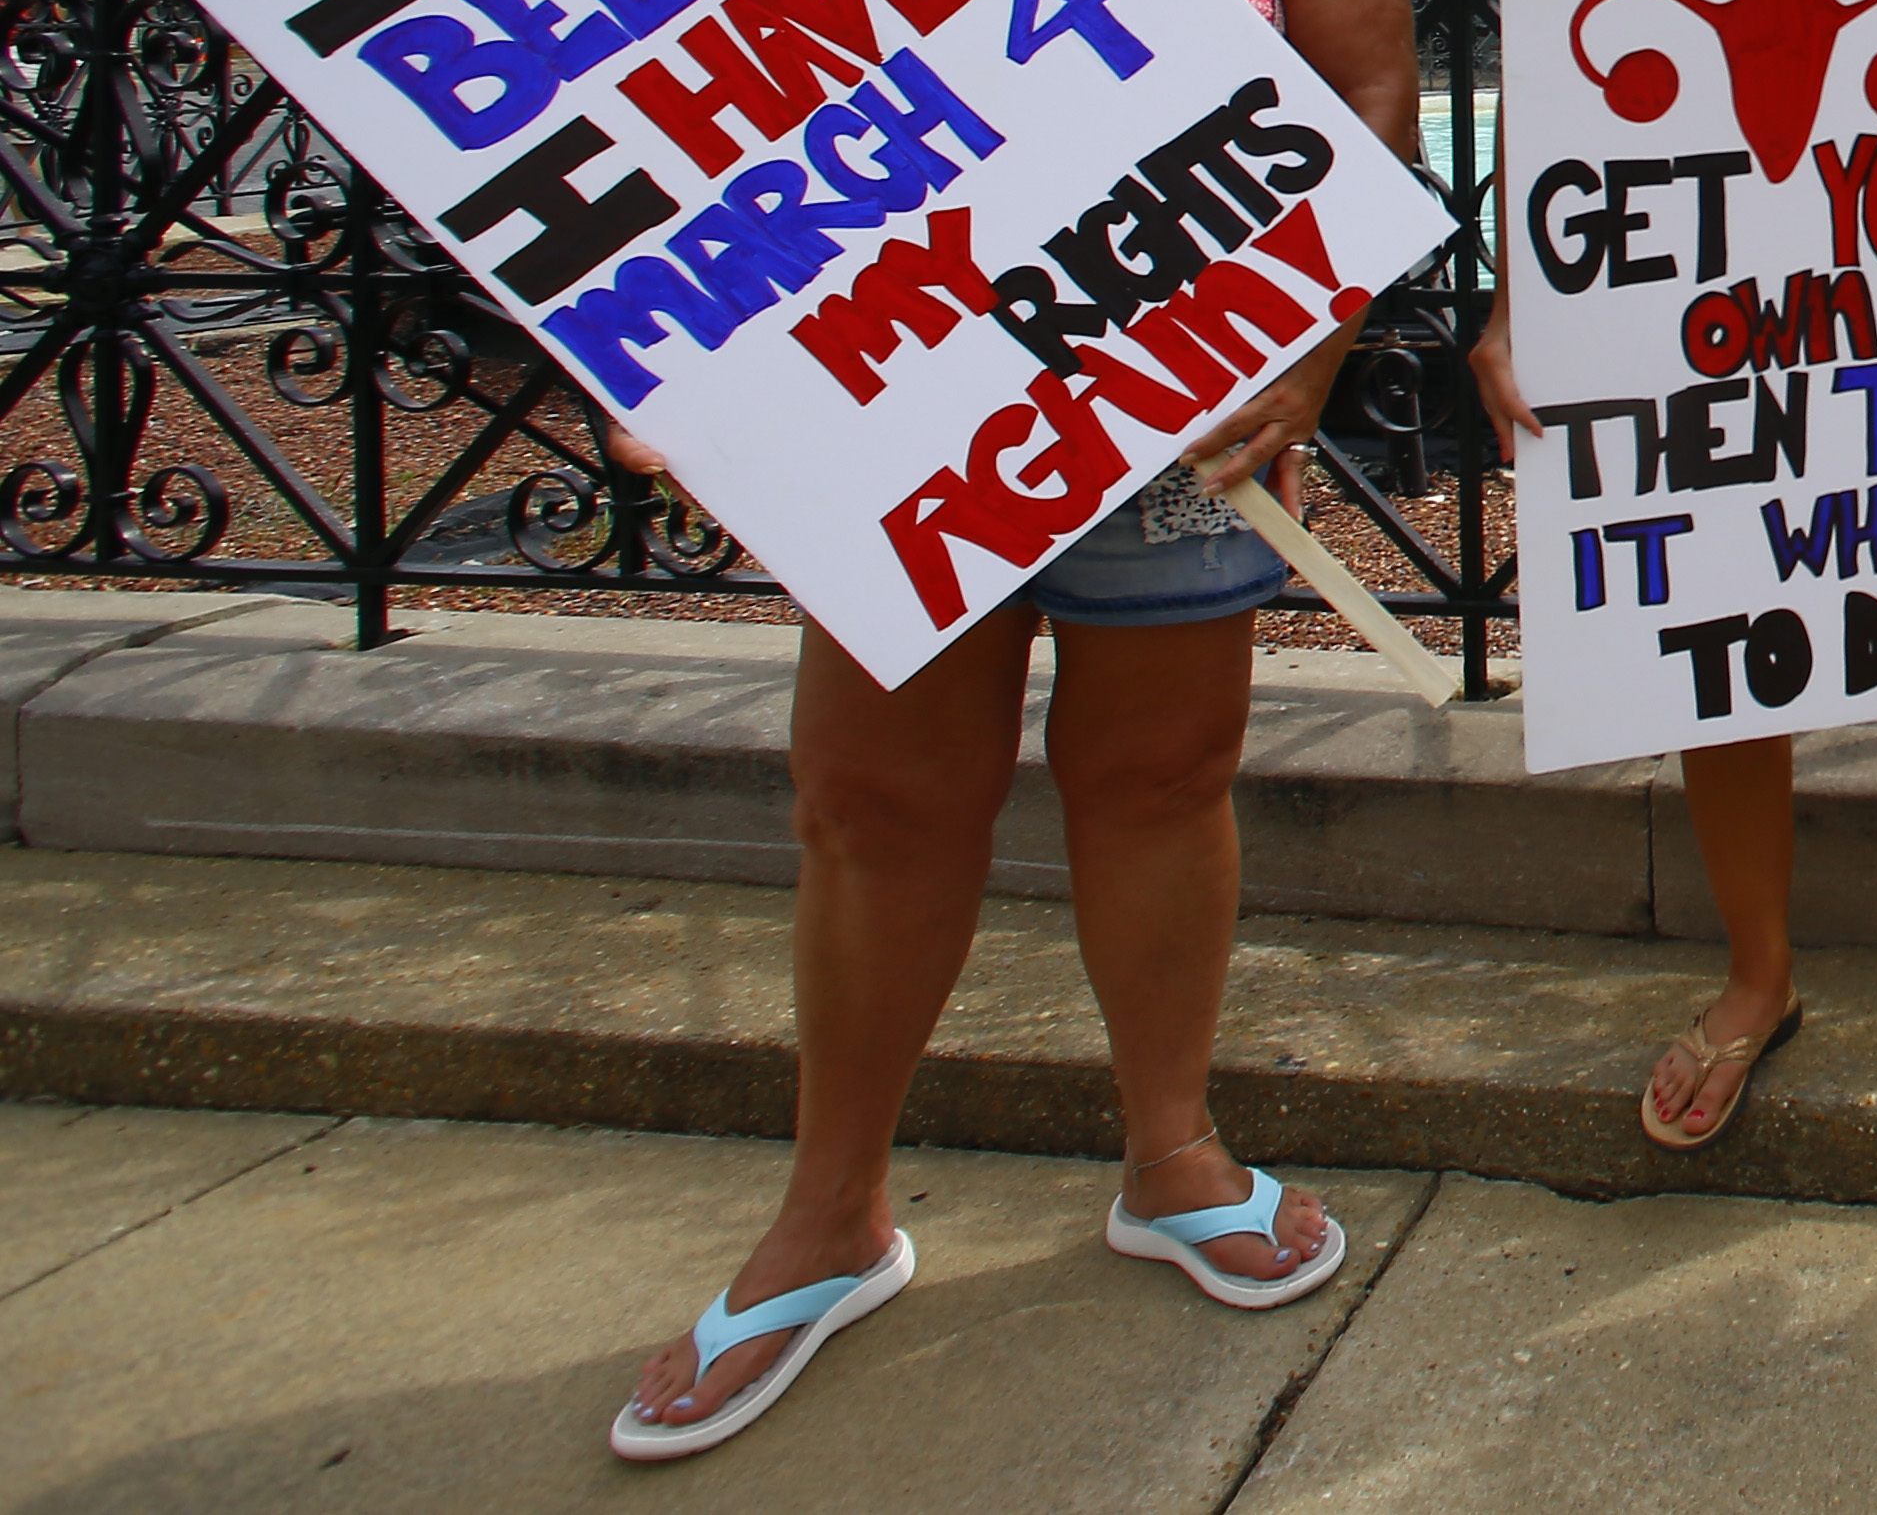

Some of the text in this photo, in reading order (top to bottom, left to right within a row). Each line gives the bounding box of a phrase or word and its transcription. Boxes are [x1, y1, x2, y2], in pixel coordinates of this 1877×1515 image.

[437, 115, 680, 305] I
[540, 46, 1007, 409] MARCH
[788, 76, 1335, 407] MY RIGHTS
[1527, 149, 1753, 296] GET
[878, 197, 1373, 631] AGAIN!
[1529, 371, 1808, 500] THEN
[1570, 513, 1695, 613] IT
[1658, 607, 1814, 721] TO
